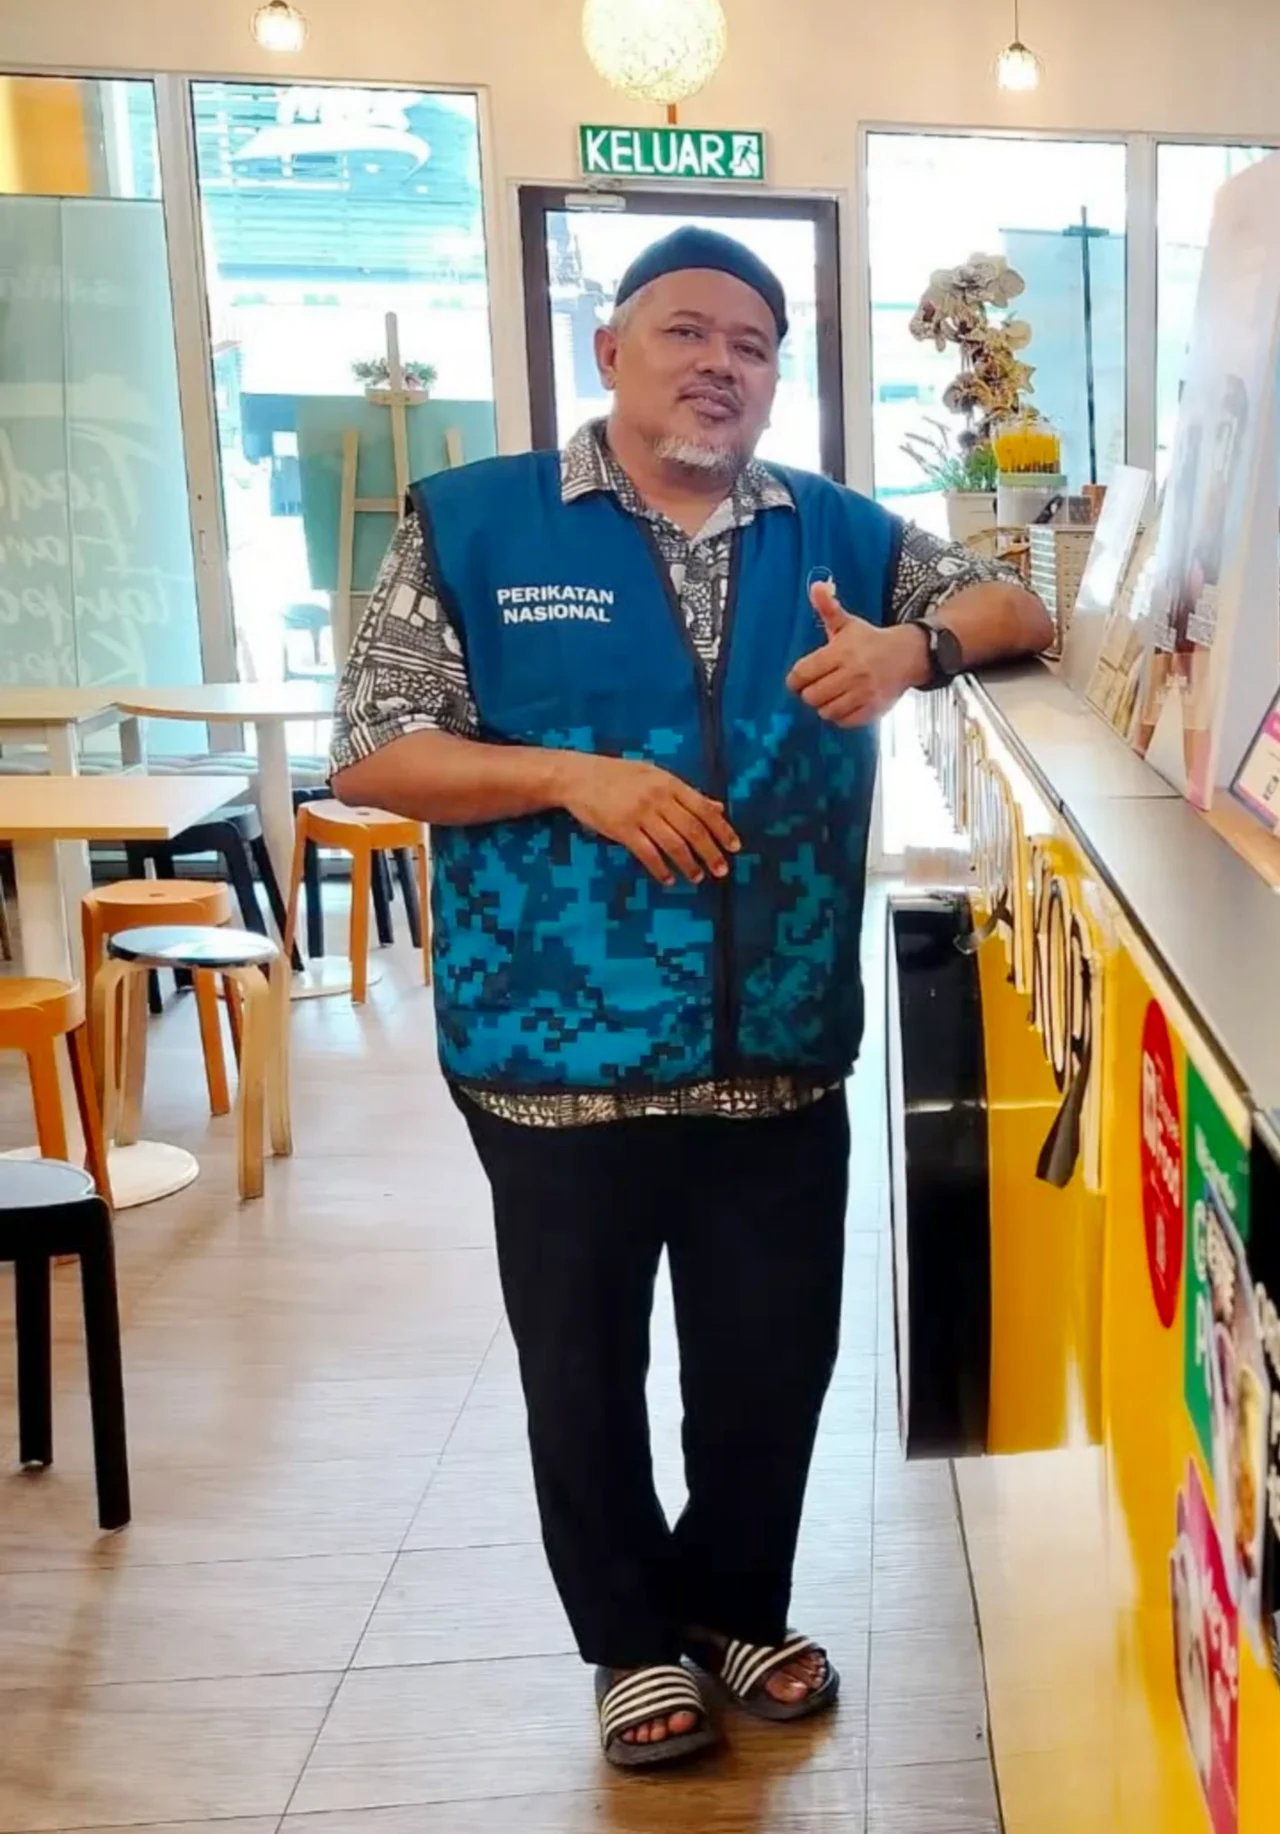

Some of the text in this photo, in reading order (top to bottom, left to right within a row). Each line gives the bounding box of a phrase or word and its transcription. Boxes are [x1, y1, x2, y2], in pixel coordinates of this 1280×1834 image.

[585, 129, 726, 177] KELUAR
[496, 584, 615, 606] PERIKATAN
[503, 603, 612, 625] NASIONAL
